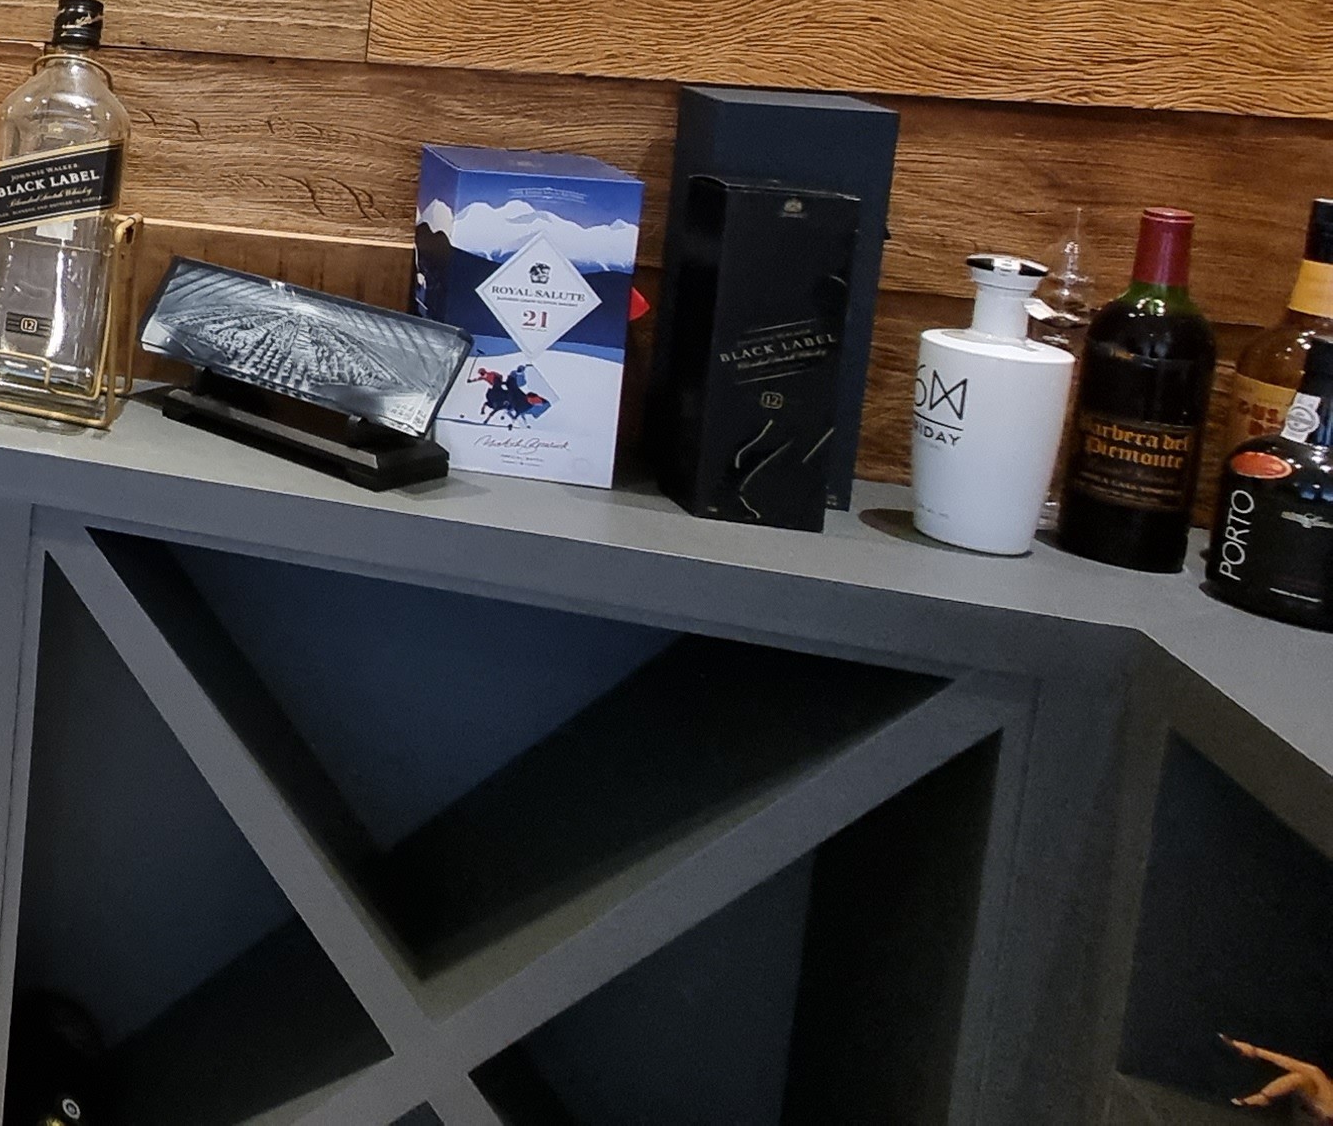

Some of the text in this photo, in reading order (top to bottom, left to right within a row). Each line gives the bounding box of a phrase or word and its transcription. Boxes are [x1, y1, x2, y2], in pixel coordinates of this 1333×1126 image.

[49, 169, 100, 187] LABEL
[491, 285, 532, 297] ROYAL
[535, 289, 586, 302] SALUTE
[24, 320, 35, 330] 12
[522, 310, 549, 329] 21
[719, 344, 774, 362] BLACK
[782, 334, 837, 350] LABEL
[1219, 489, 1255, 582] PORTO
